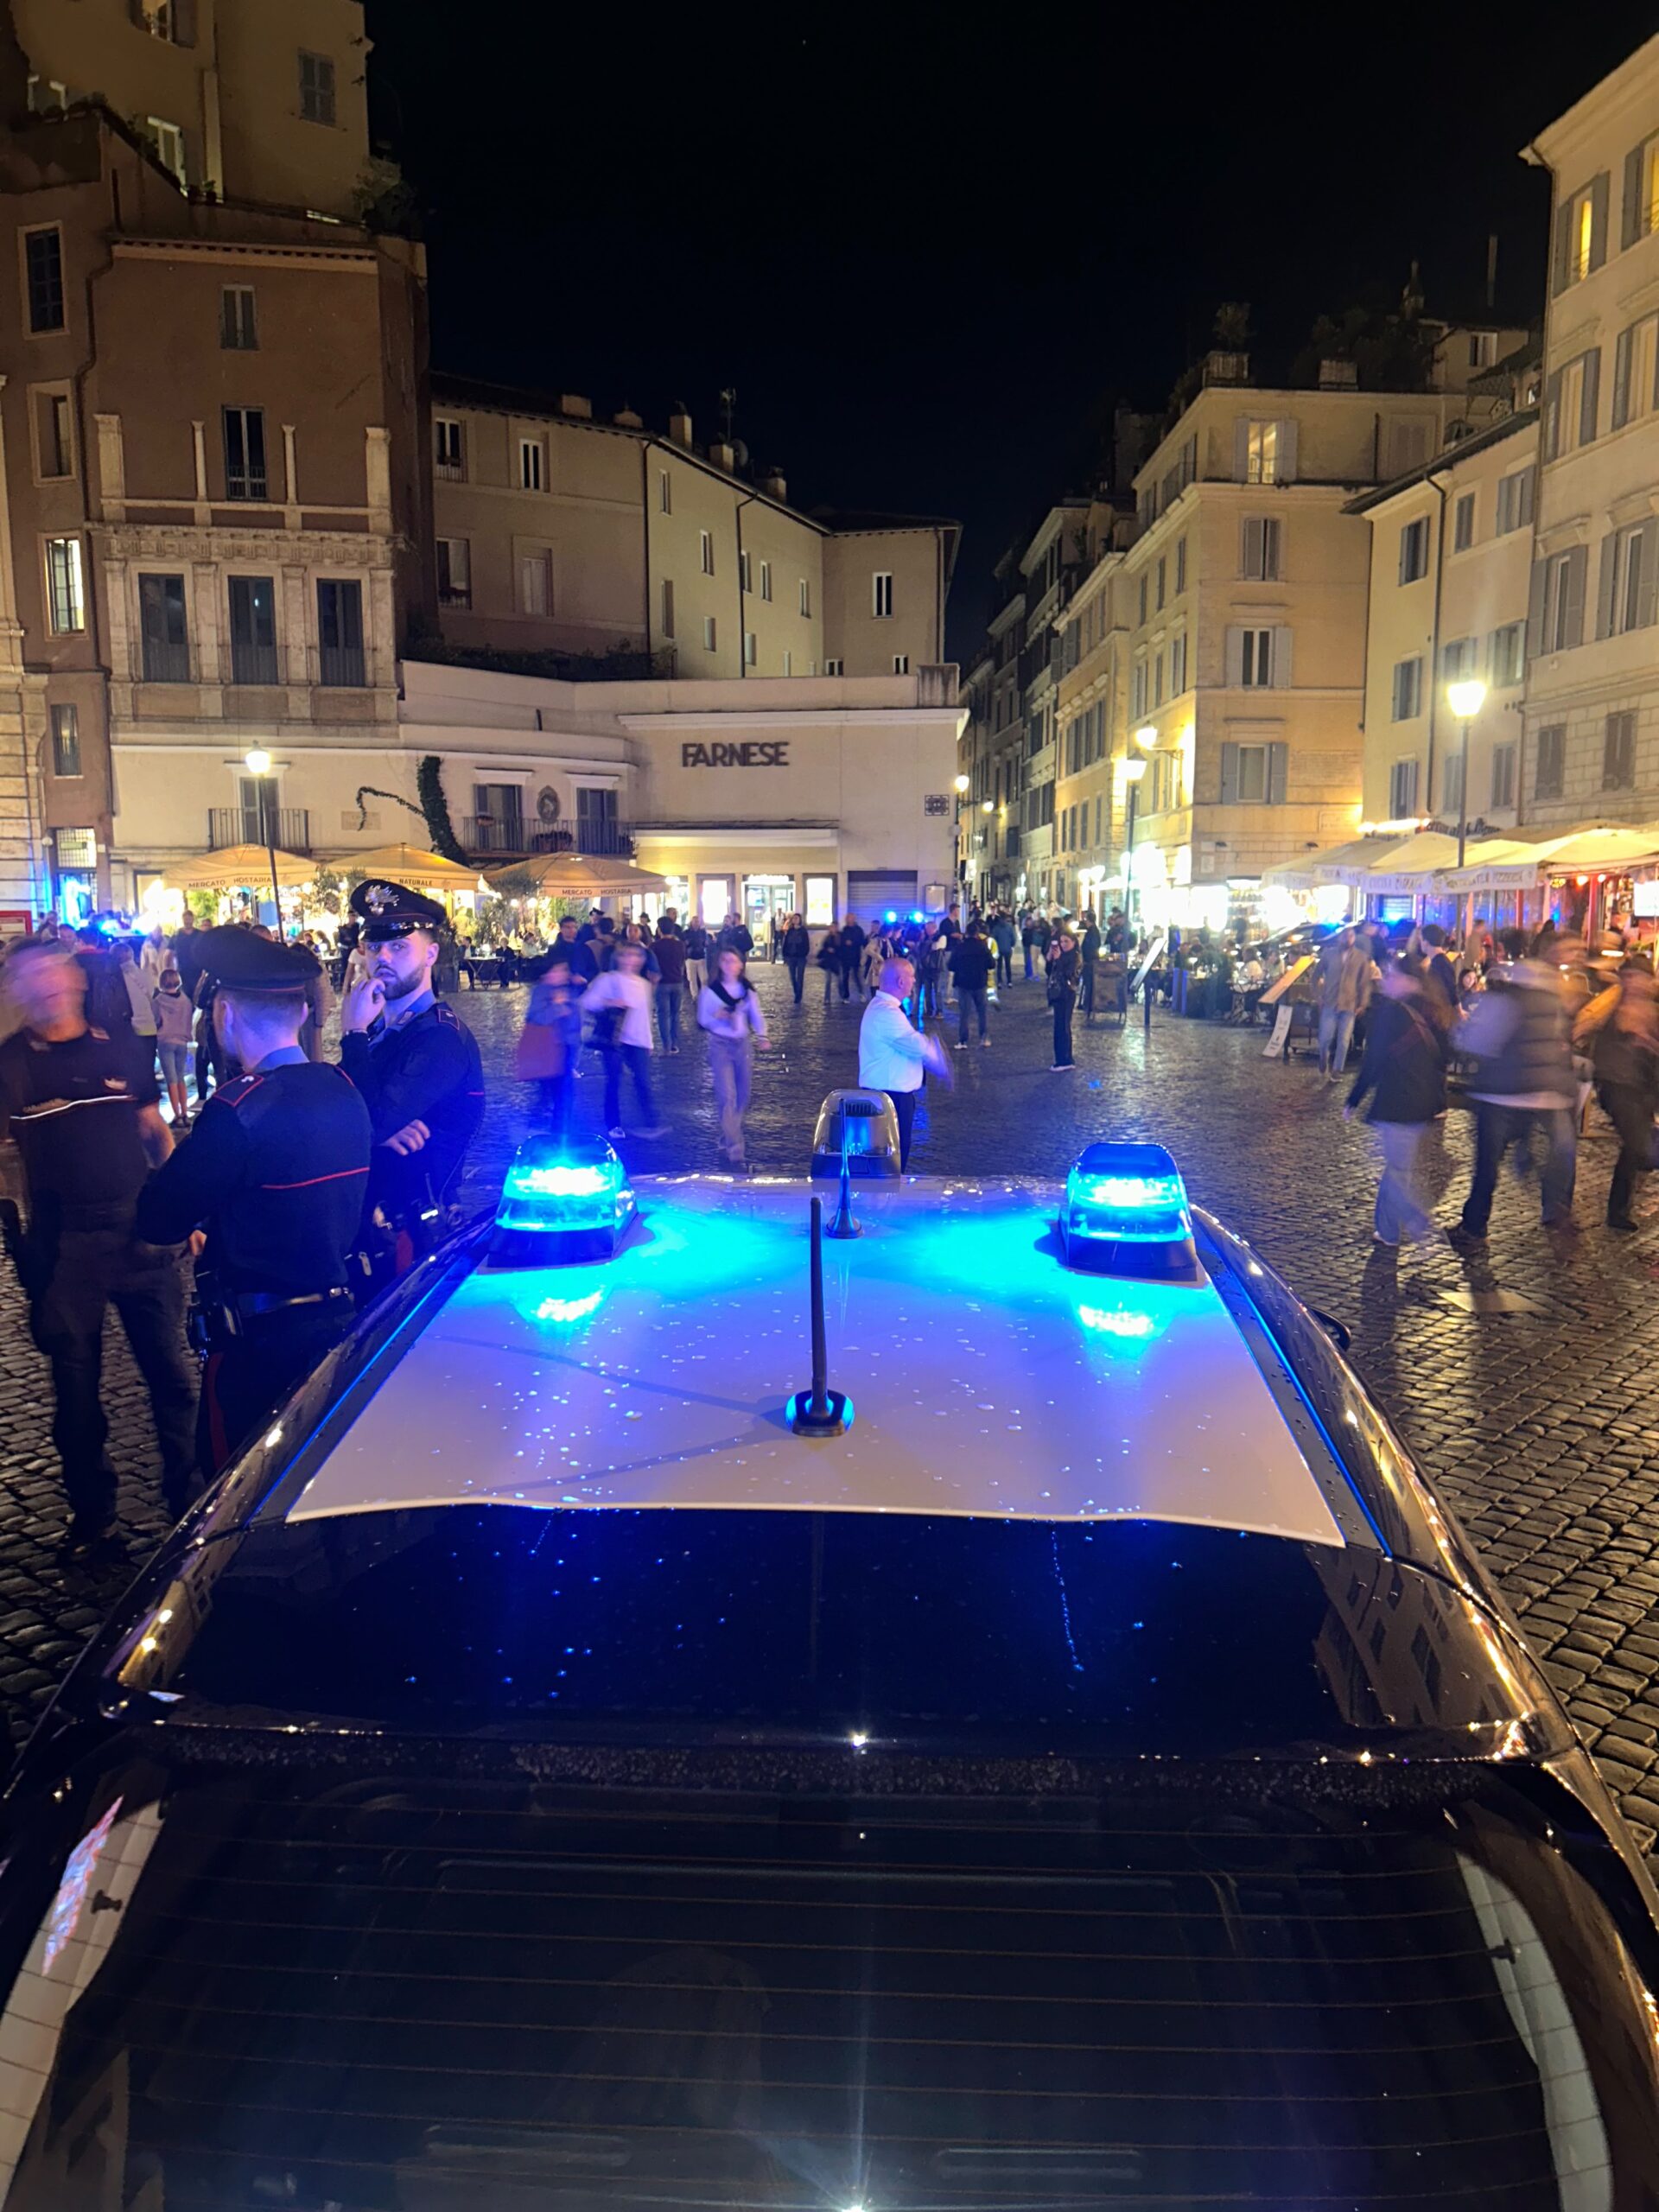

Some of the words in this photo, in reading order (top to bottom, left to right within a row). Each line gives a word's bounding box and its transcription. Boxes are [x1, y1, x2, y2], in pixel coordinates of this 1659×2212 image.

[682, 741, 790, 767] FARNESE
[188, 880, 226, 889] MERCATO
[233, 876, 272, 885] HOSTARIA
[398, 878, 433, 887] NATURALE
